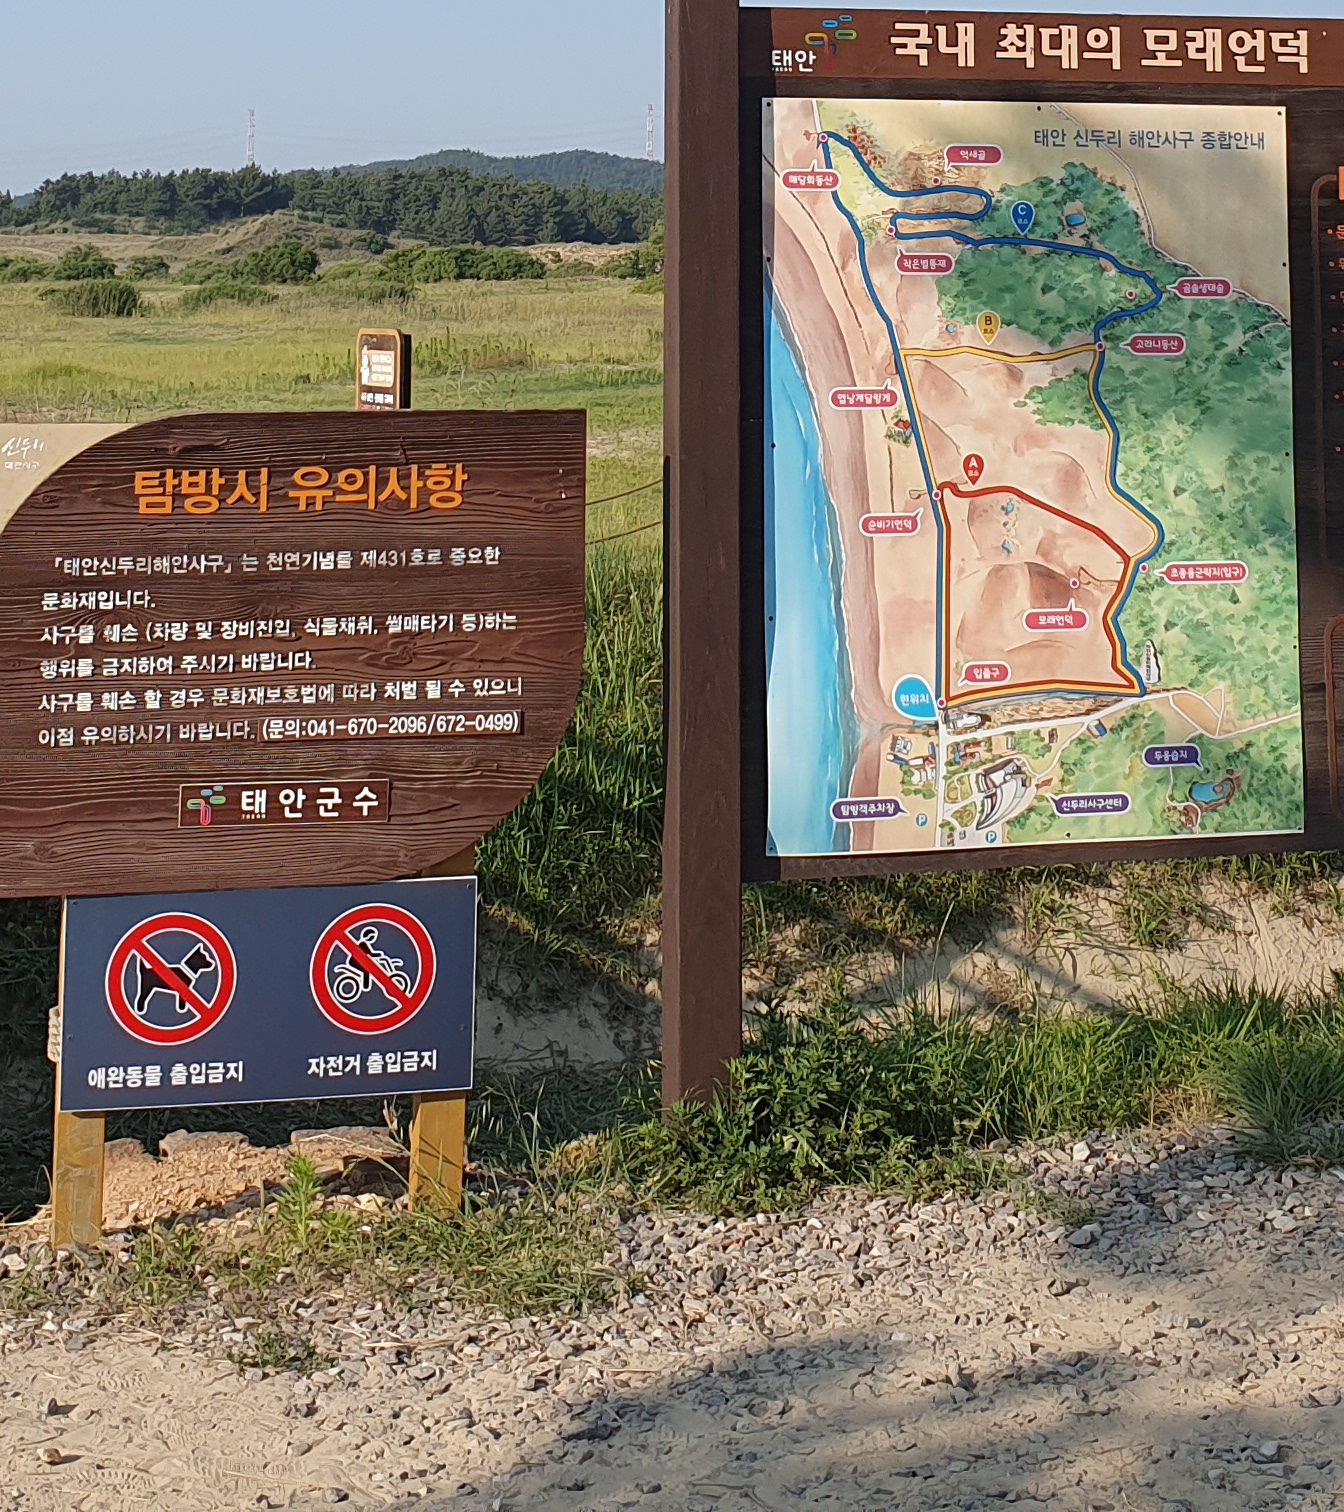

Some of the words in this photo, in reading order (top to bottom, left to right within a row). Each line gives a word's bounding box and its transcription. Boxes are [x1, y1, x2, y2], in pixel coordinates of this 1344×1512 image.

[771, 50, 817, 72] 태안
[890, 22, 975, 67] 국내
[996, 23, 1121, 70] 최대의
[1141, 29, 1308, 74] 모래언덕
[1034, 129, 1066, 148] 태안
[1073, 129, 1121, 148] 신두리
[1129, 130, 1194, 149] 해안사구
[1201, 131, 1265, 150] 종합안내
[134, 467, 269, 515] 탐방시
[289, 463, 468, 510] 유의사항
[266, 550, 353, 571] 천연기념물
[360, 548, 443, 568] 제431호로
[449, 546, 501, 566] 중요한
[42, 590, 156, 610] 문화재입니다.
[40, 624, 95, 644] 사구를
[104, 622, 138, 643] 훼손
[145, 621, 189, 642] (차량
[196, 621, 212, 640] 및
[220, 619, 296, 639] 장비진입,
[386, 613, 454, 633] 썰매타기
[461, 612, 518, 632] 등)하는
[40, 658, 94, 679] 행위를
[102, 656, 173, 676] 금지하여
[180, 654, 234, 674] 주시기
[241, 651, 316, 671] 바랍니다.
[973, 667, 1001, 679] 입출구
[38, 692, 94, 713] 사구를
[101, 691, 136, 711] 훼손
[144, 690, 161, 709] 할
[170, 688, 204, 708] 경우
[211, 683, 335, 706] 문화재보호법에
[342, 682, 377, 702] 따라
[384, 681, 418, 700] 처벌
[426, 679, 442, 699] 될
[448, 679, 466, 698] 수
[473, 677, 522, 697] 있으니
[38, 727, 74, 747] 이점
[81, 723, 171, 746] 유의하시기
[179, 721, 255, 743] 바랍니다.
[262, 712, 518, 740] (문의:041-670-2096/672-0499)
[1061, 799, 1123, 811] 신두리사구센터
[87, 1063, 162, 1089] 애완동물
[169, 1060, 244, 1087] 출입금지
[307, 1053, 361, 1078] 자전거
[366, 1048, 438, 1075] 출입금지
